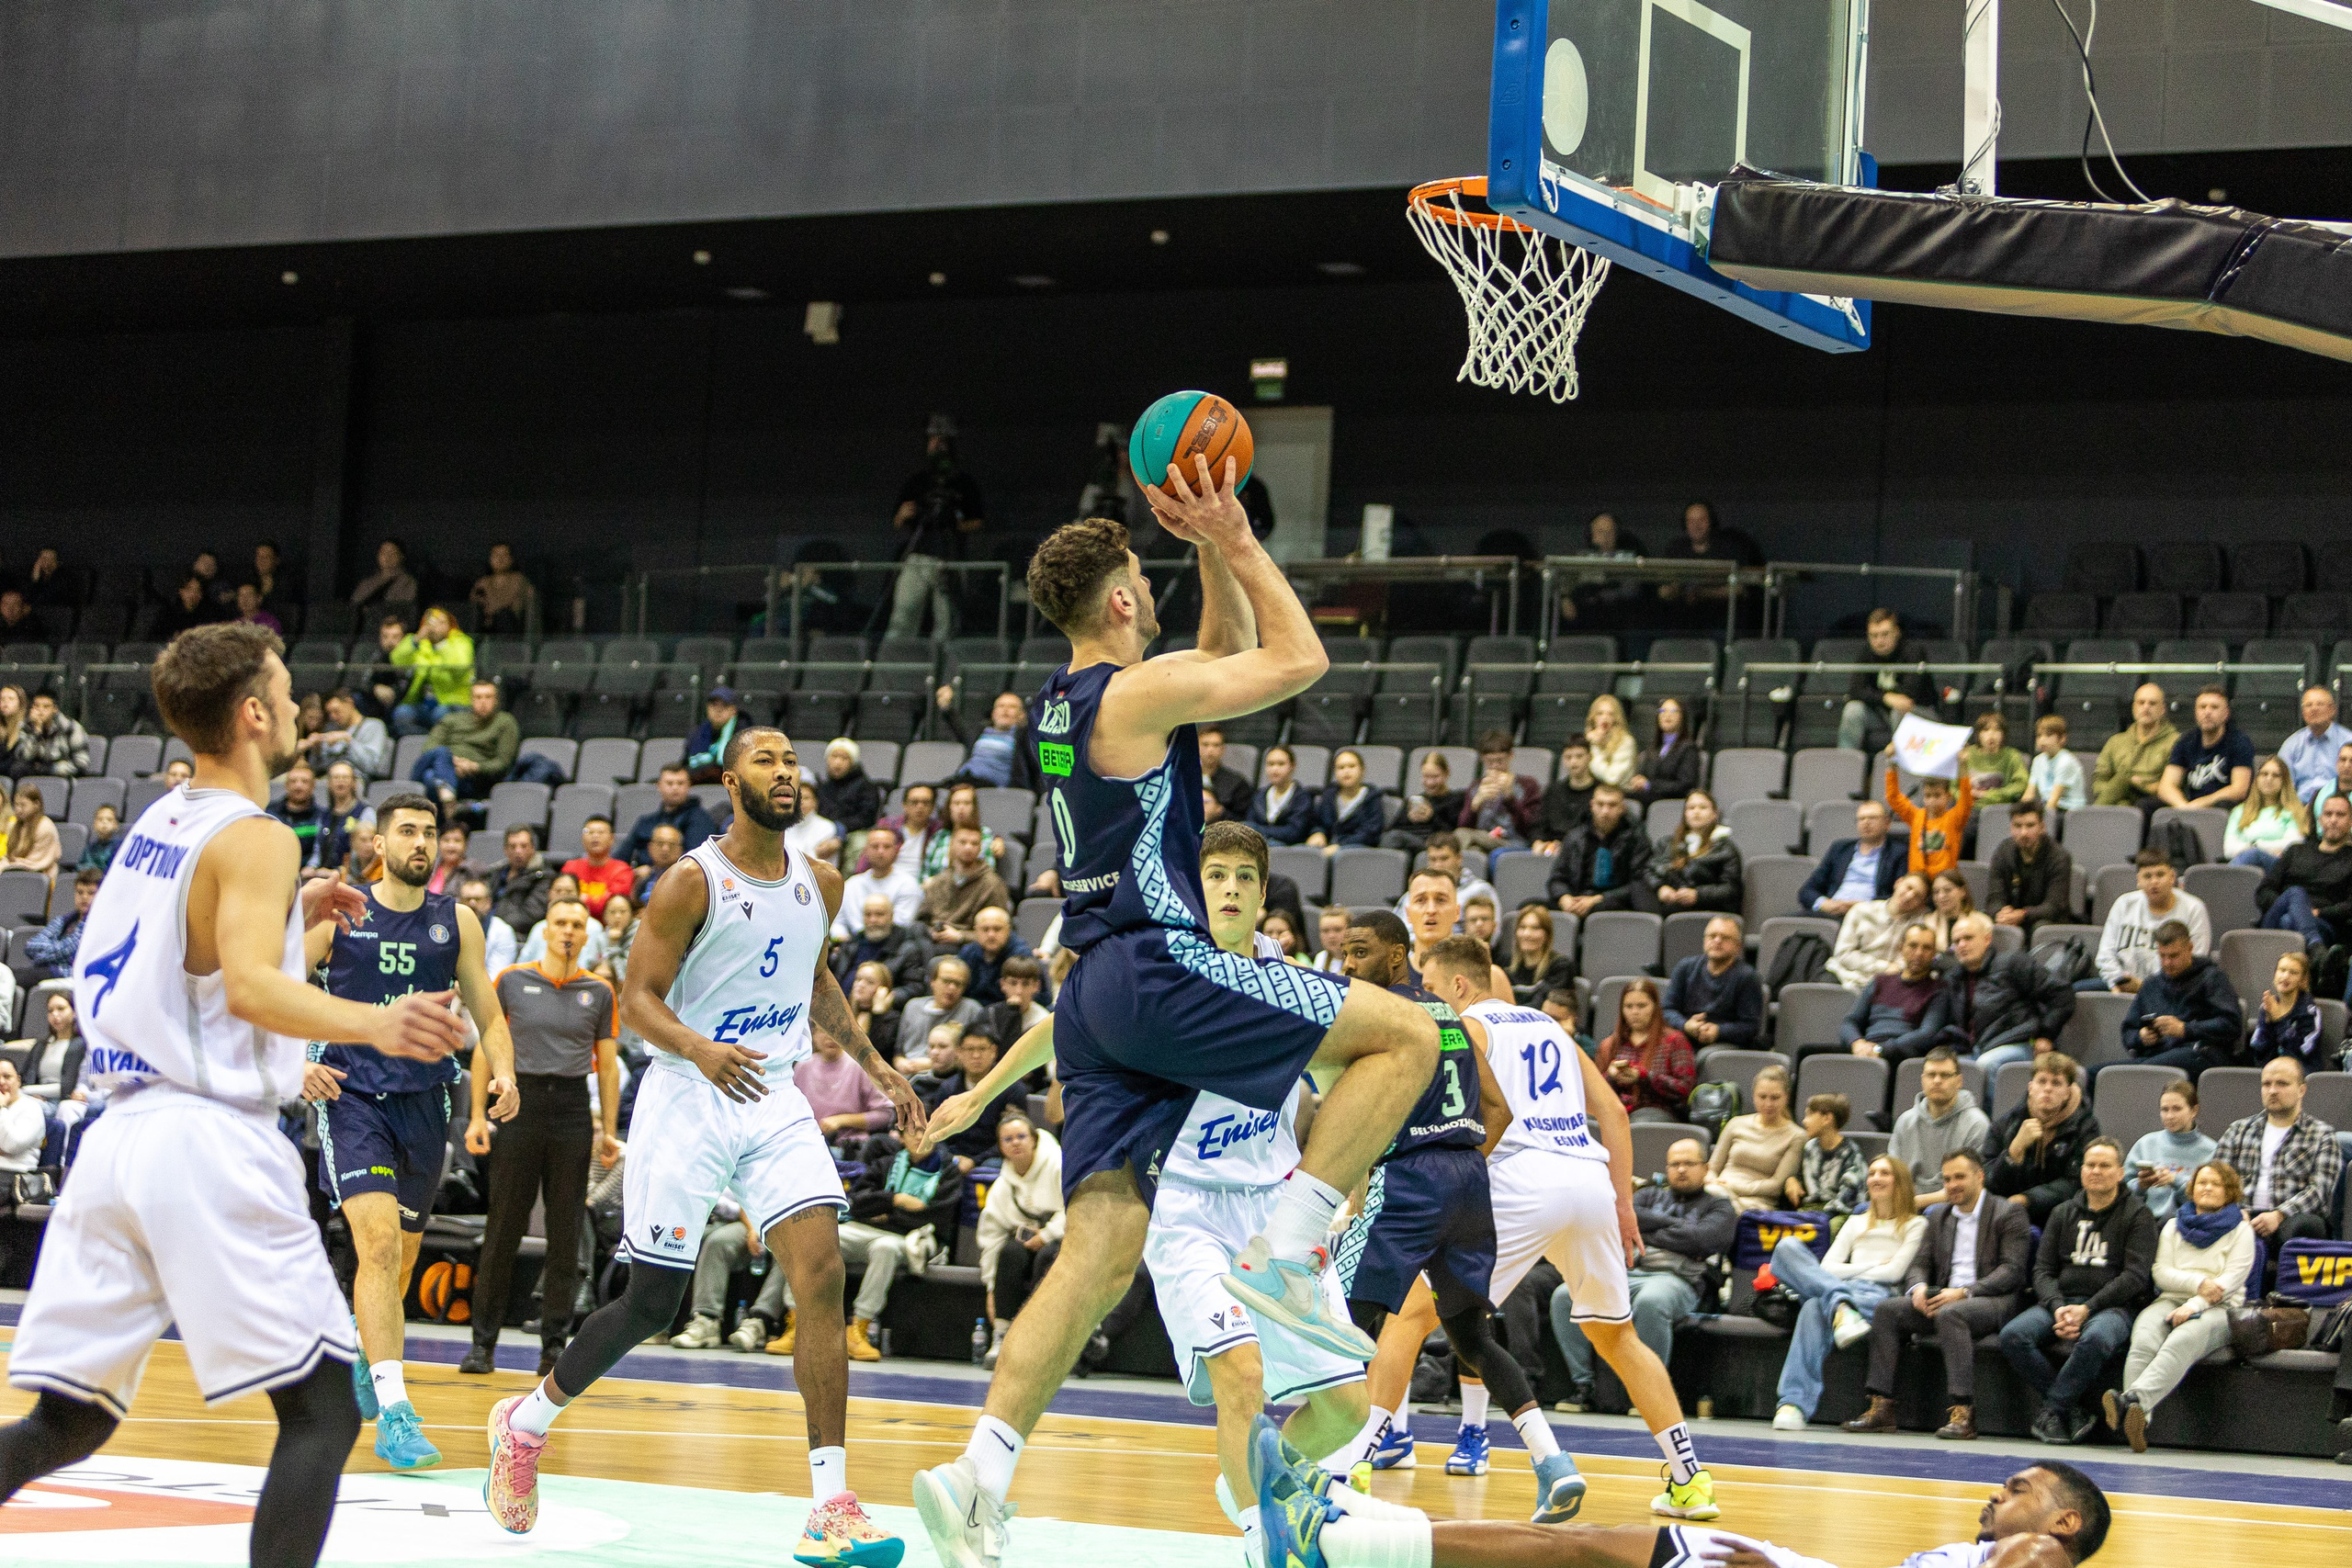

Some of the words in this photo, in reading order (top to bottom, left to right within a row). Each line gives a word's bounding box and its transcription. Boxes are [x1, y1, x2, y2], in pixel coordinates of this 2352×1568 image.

[1051, 787, 1076, 868] 0
[349, 930, 379, 939] Kempa
[379, 942, 417, 976] 55
[760, 935, 784, 977] 5
[713, 1002, 802, 1043] Enisey
[1442, 1059, 1465, 1117] 3
[1520, 1039, 1563, 1100] 12
[1197, 1110, 1281, 1159] Enisey
[340, 1168, 368, 1181] Kempa
[664, 1242, 685, 1250] ENISEY
[1758, 1224, 1817, 1251] VIP
[2297, 1255, 2352, 1287] VIP
